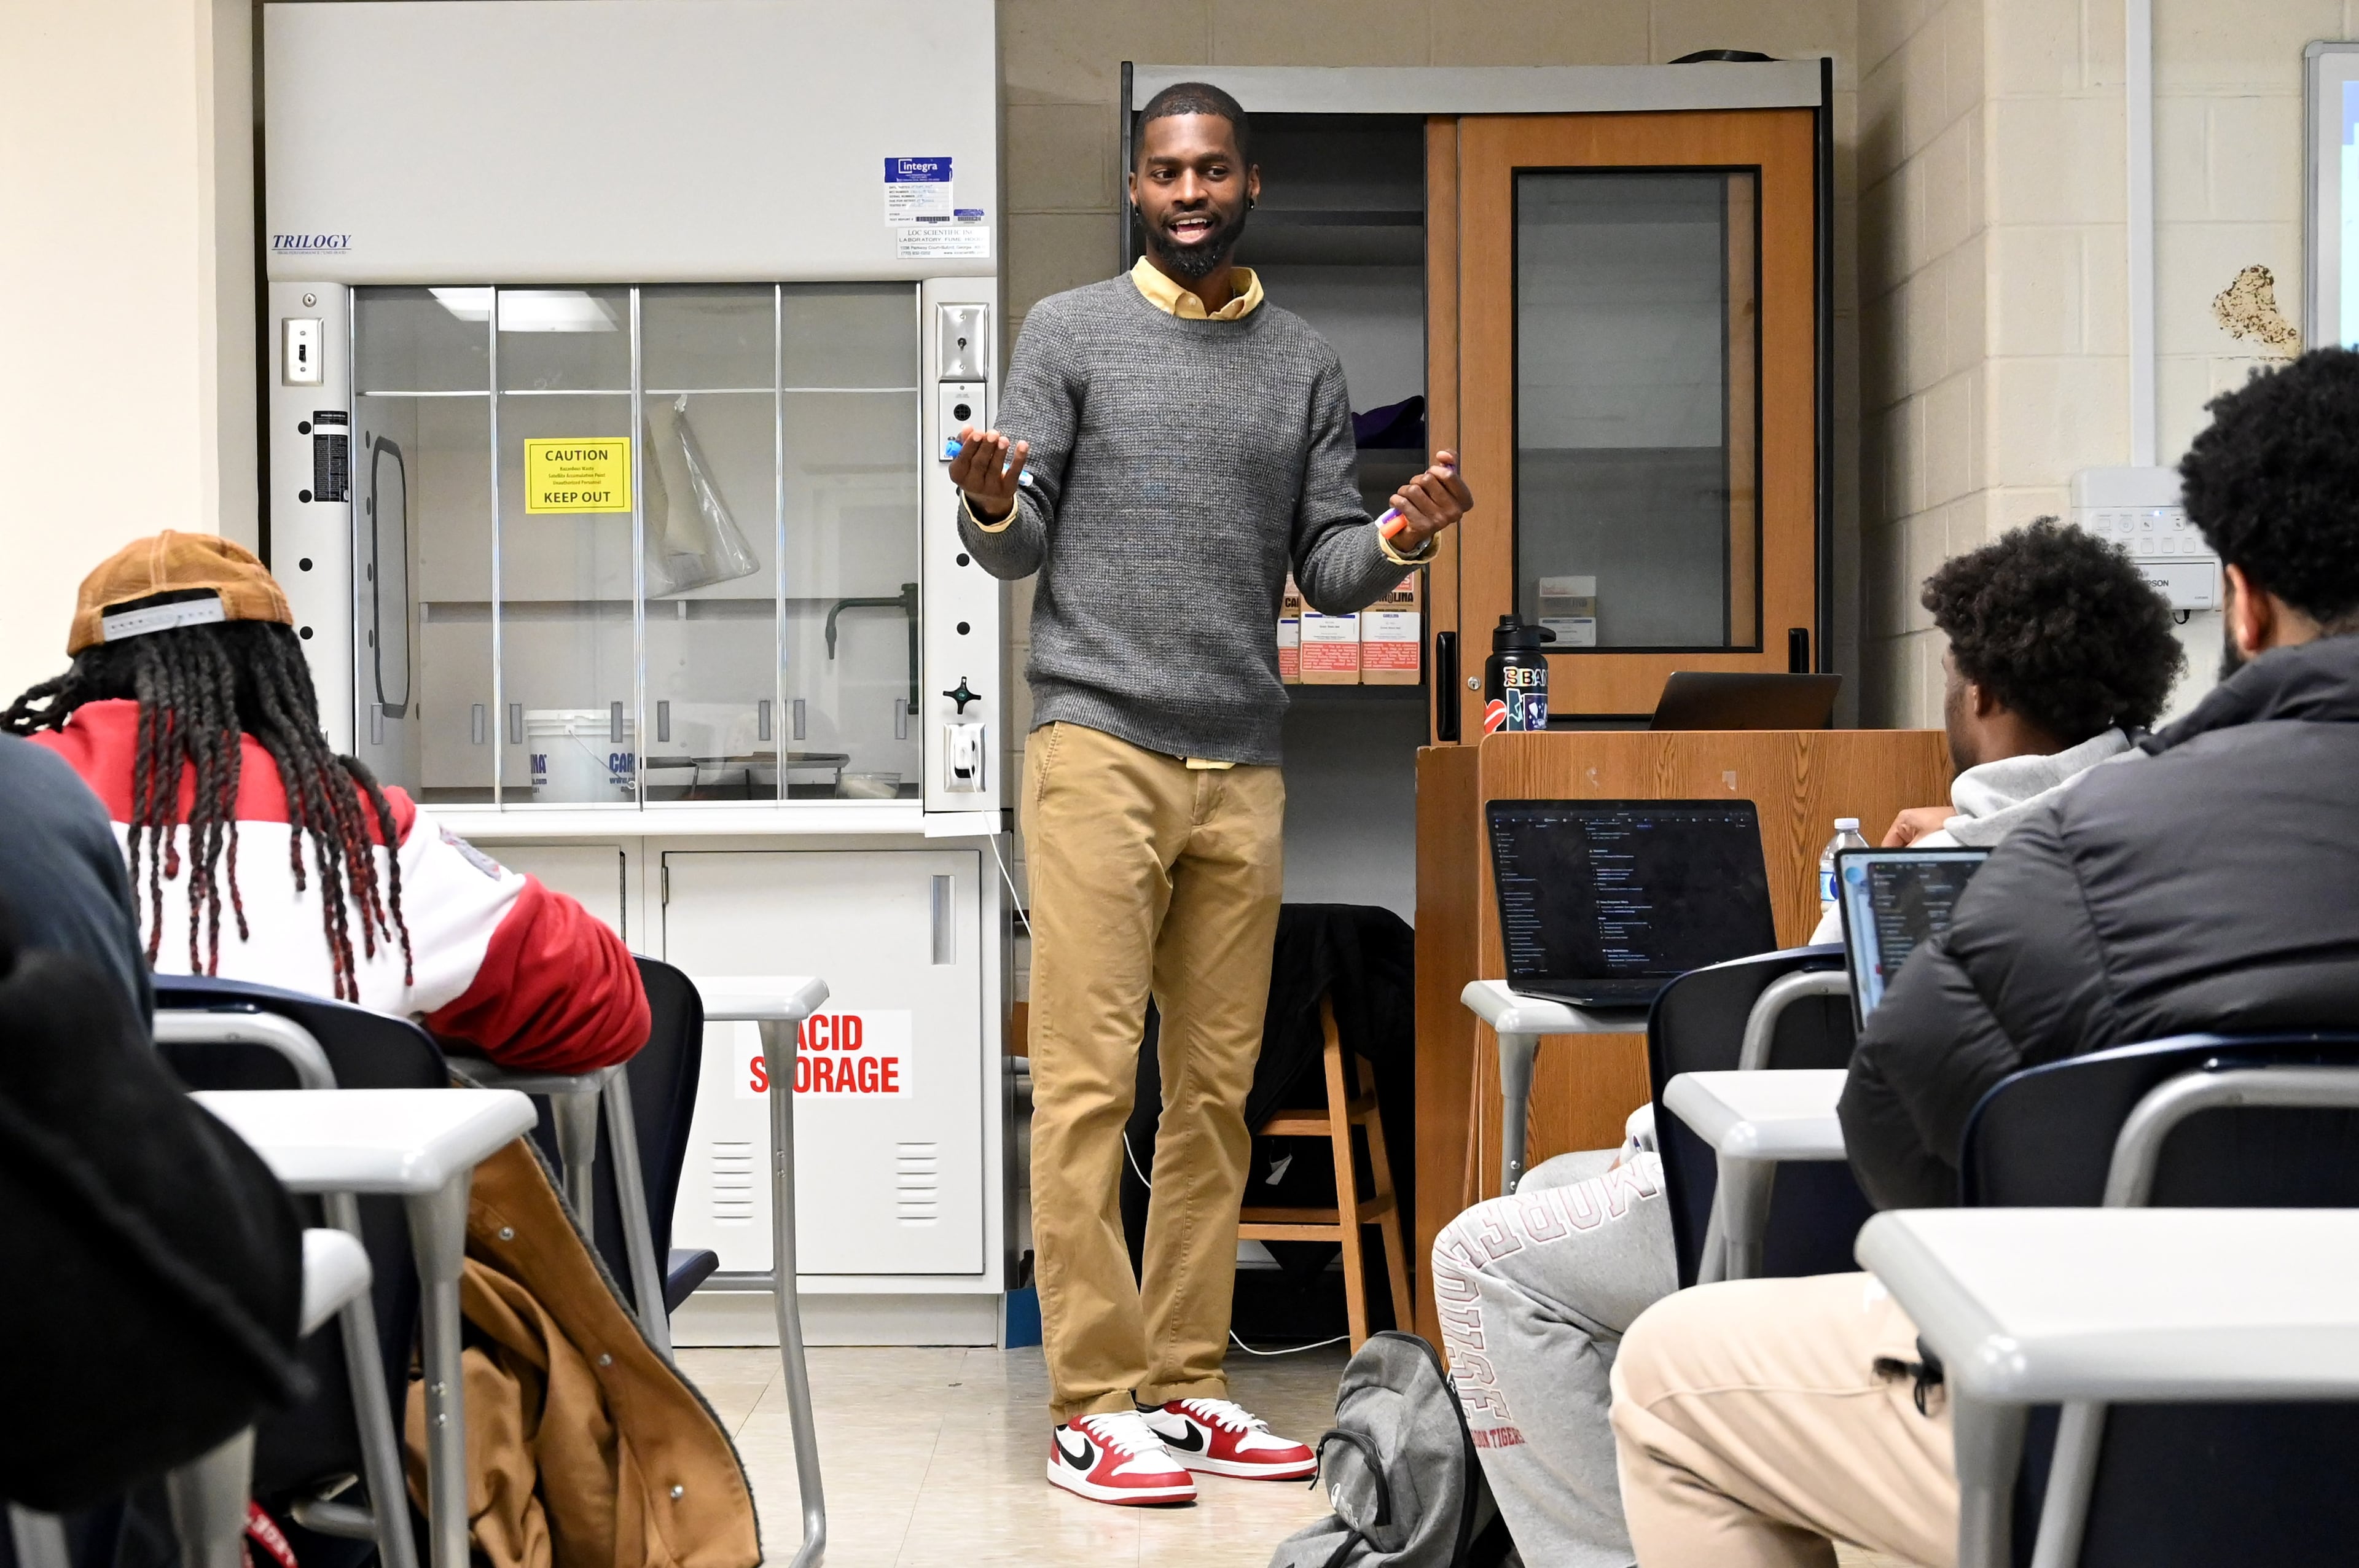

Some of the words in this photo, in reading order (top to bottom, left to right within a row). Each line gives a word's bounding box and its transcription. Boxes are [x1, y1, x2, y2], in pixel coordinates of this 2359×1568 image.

[904, 162, 937, 172] integra
[273, 234, 351, 248] TRILOGY
[545, 450, 608, 461] CAUTION
[544, 492, 578, 503] KEEP
[582, 491, 611, 502] OUT
[1379, 591, 1414, 604] ROLINA
[749, 1056, 899, 1093] SORAGE
[1489, 1427, 1526, 1449] TIGERS
